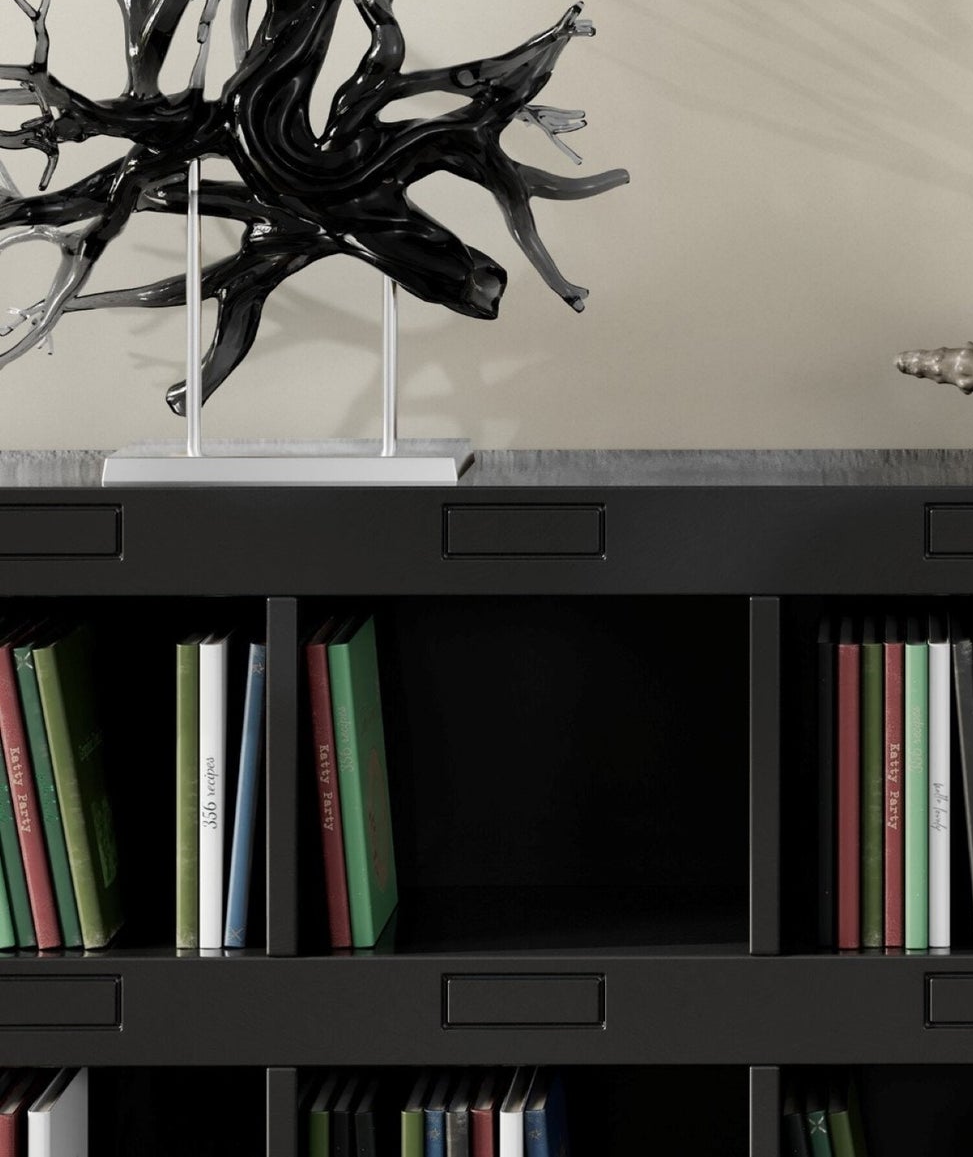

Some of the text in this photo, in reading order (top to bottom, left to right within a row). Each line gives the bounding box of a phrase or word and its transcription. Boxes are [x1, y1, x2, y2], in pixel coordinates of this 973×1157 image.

[9, 747, 31, 833] Katty Party
[202, 757, 219, 829] 356 recipes
[319, 744, 334, 832] Katty Party
[887, 743, 900, 831] Katty Party
